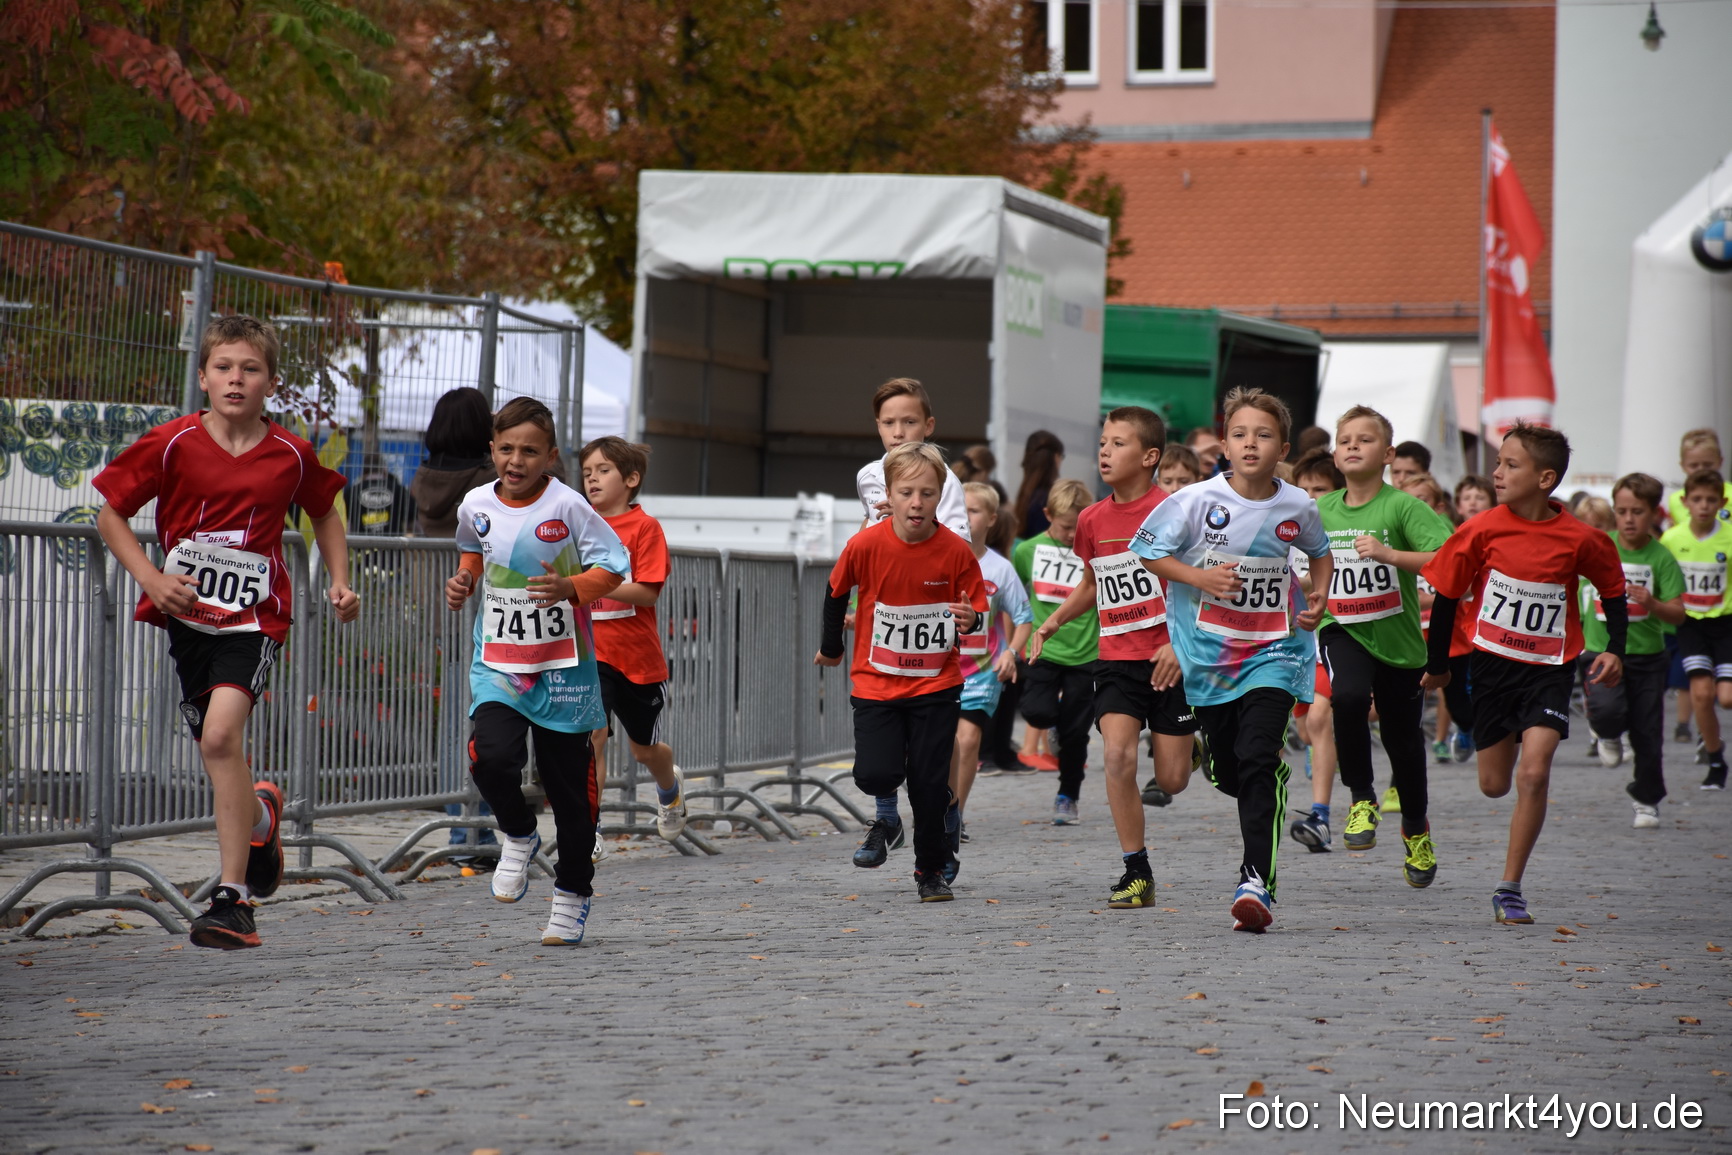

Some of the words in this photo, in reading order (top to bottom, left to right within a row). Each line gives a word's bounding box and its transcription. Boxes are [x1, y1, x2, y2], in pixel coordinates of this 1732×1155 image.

[540, 525, 566, 536] Hervis
[1137, 528, 1153, 543] CK
[1205, 532, 1229, 542] PARTL
[1280, 525, 1298, 537] Hervis
[207, 535, 231, 544] DEHN
[174, 545, 204, 561] PARTL
[207, 554, 255, 571] Neumarkt
[1103, 559, 1137, 572] Neumarkt
[1240, 565, 1280, 574] Neumarkt
[1041, 558, 1084, 583] 717
[1098, 568, 1152, 604] 7056
[1333, 565, 1391, 595] 7049
[1489, 577, 1514, 594] PARTL
[1687, 574, 1721, 593] 144
[1215, 578, 1282, 609] 555
[1516, 588, 1556, 600] Neumarkt
[1337, 599, 1386, 614] Benjamin
[1491, 591, 1561, 633] 7107
[875, 608, 901, 621] PARTL
[903, 611, 940, 620] Neumarkt
[1108, 605, 1149, 624] Benedikt
[492, 606, 565, 640] 7413
[881, 620, 947, 650] 7164
[1499, 633, 1536, 651] Jamie
[898, 656, 924, 668] Luca
[546, 670, 566, 684] 16.
